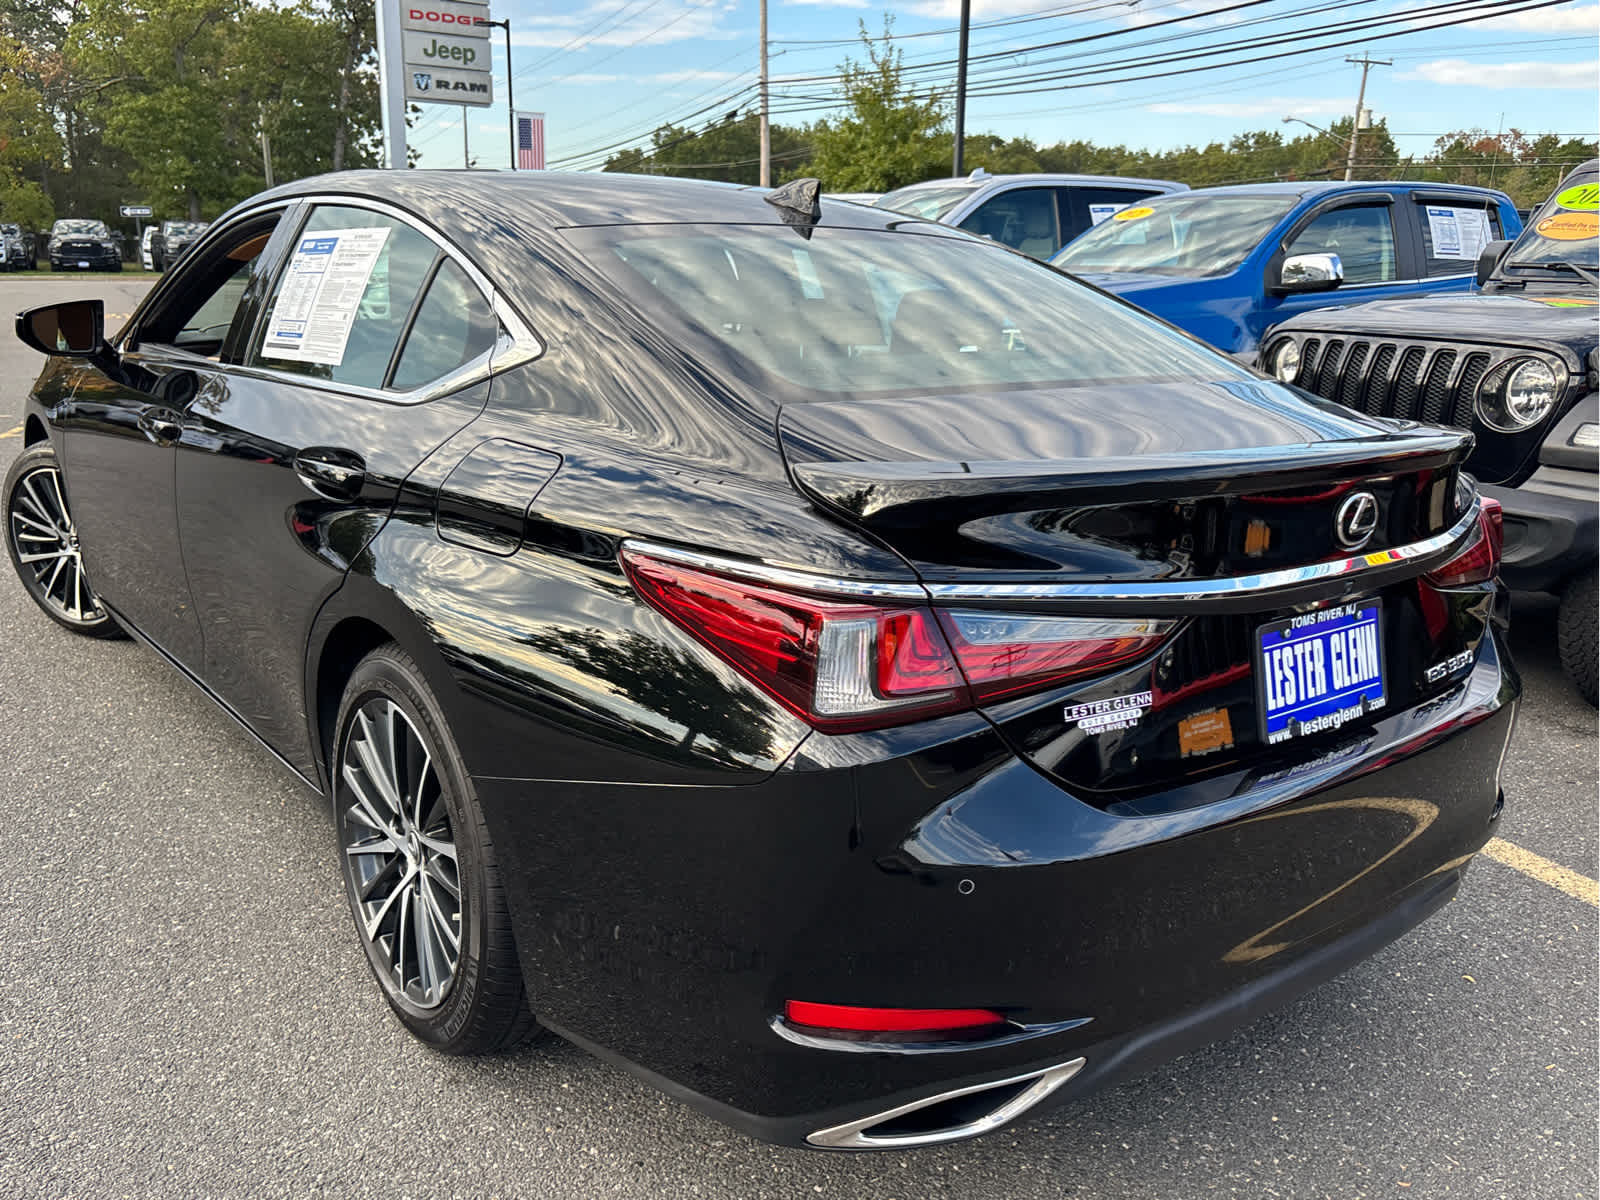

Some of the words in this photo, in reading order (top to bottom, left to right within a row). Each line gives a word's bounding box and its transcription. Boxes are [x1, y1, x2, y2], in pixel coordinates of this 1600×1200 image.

[423, 39, 476, 65] Jeep
[436, 79, 488, 93] RAM
[1290, 613, 1316, 629] TOMS
[1345, 603, 1357, 617] NJ
[1264, 638, 1326, 711] LESTER
[1330, 624, 1379, 691] GLENN
[1064, 701, 1111, 720] LESTER
[1113, 693, 1152, 710] GLENN
[1081, 717, 1105, 727] AUTO
[1110, 710, 1140, 721] GROUP
[1085, 726, 1106, 736] TOMS
[1129, 718, 1138, 727] NJ
[1300, 706, 1363, 737] lesterglenn
